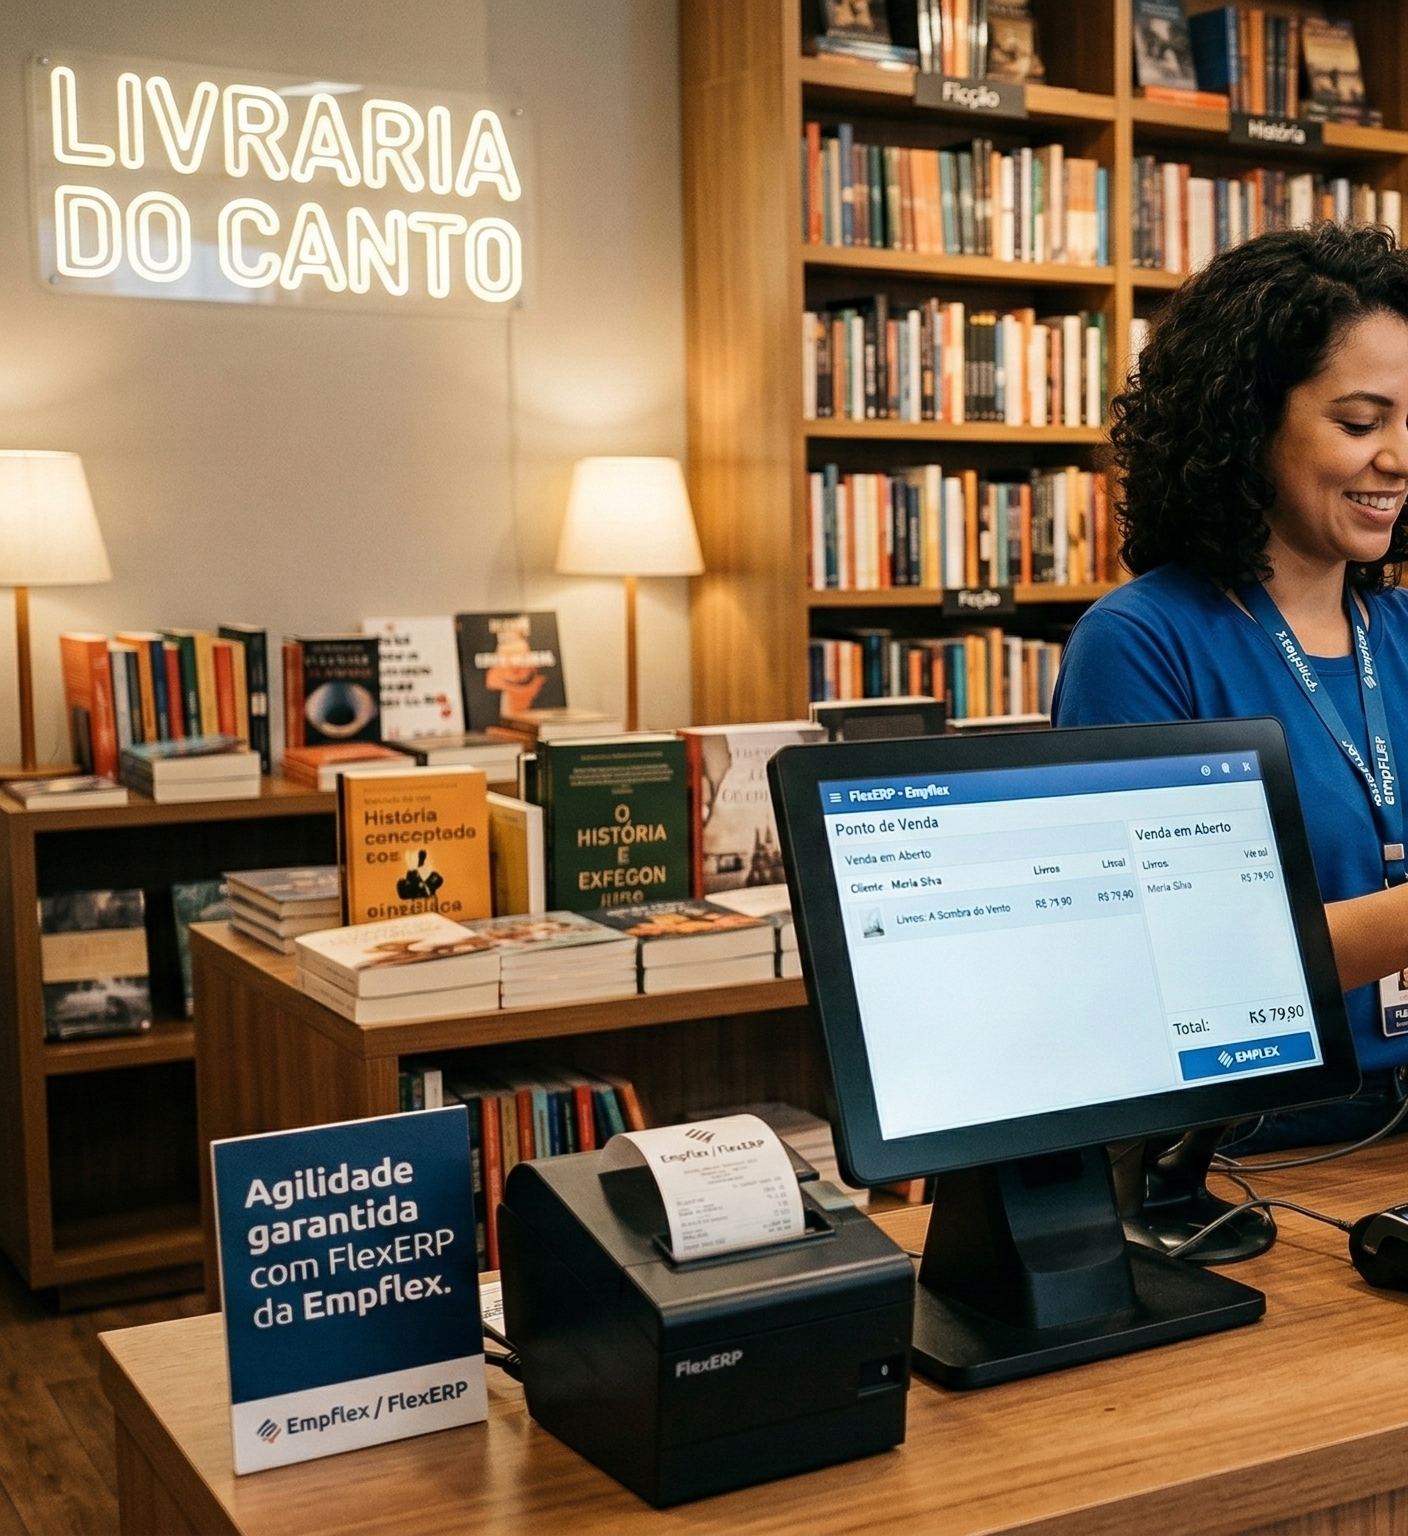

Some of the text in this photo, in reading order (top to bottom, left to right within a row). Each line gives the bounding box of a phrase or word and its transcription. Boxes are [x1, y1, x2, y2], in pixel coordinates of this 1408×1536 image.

[50, 66, 522, 201] LIVRARIA
[55, 184, 523, 303] DO CANTO
[364, 807, 438, 826] História
[615, 803, 630, 823] O
[577, 819, 667, 848] HISTÓRIA
[835, 816, 939, 837] Ponto de Venda
[1135, 822, 1231, 841] Venda em Aberto
[618, 846, 630, 864] E
[845, 849, 932, 866] Venda em Aberto
[578, 865, 667, 891] EXFEGON
[929, 912, 936, 921] A
[973, 906, 984, 916] do
[985, 904, 1011, 915] Vento
[1173, 1018, 1210, 1036] Total:
[1235, 1045, 1280, 1064] EMPLEX
[244, 1156, 413, 1210] Agilidade
[248, 1195, 418, 1256] garantida
[250, 1228, 455, 1289] com FlexERP
[253, 1298, 293, 1329] da
[303, 1273, 452, 1321] Empflex.
[675, 1349, 743, 1378] FlexERP
[287, 1380, 468, 1435] Empflex / FlexERP
